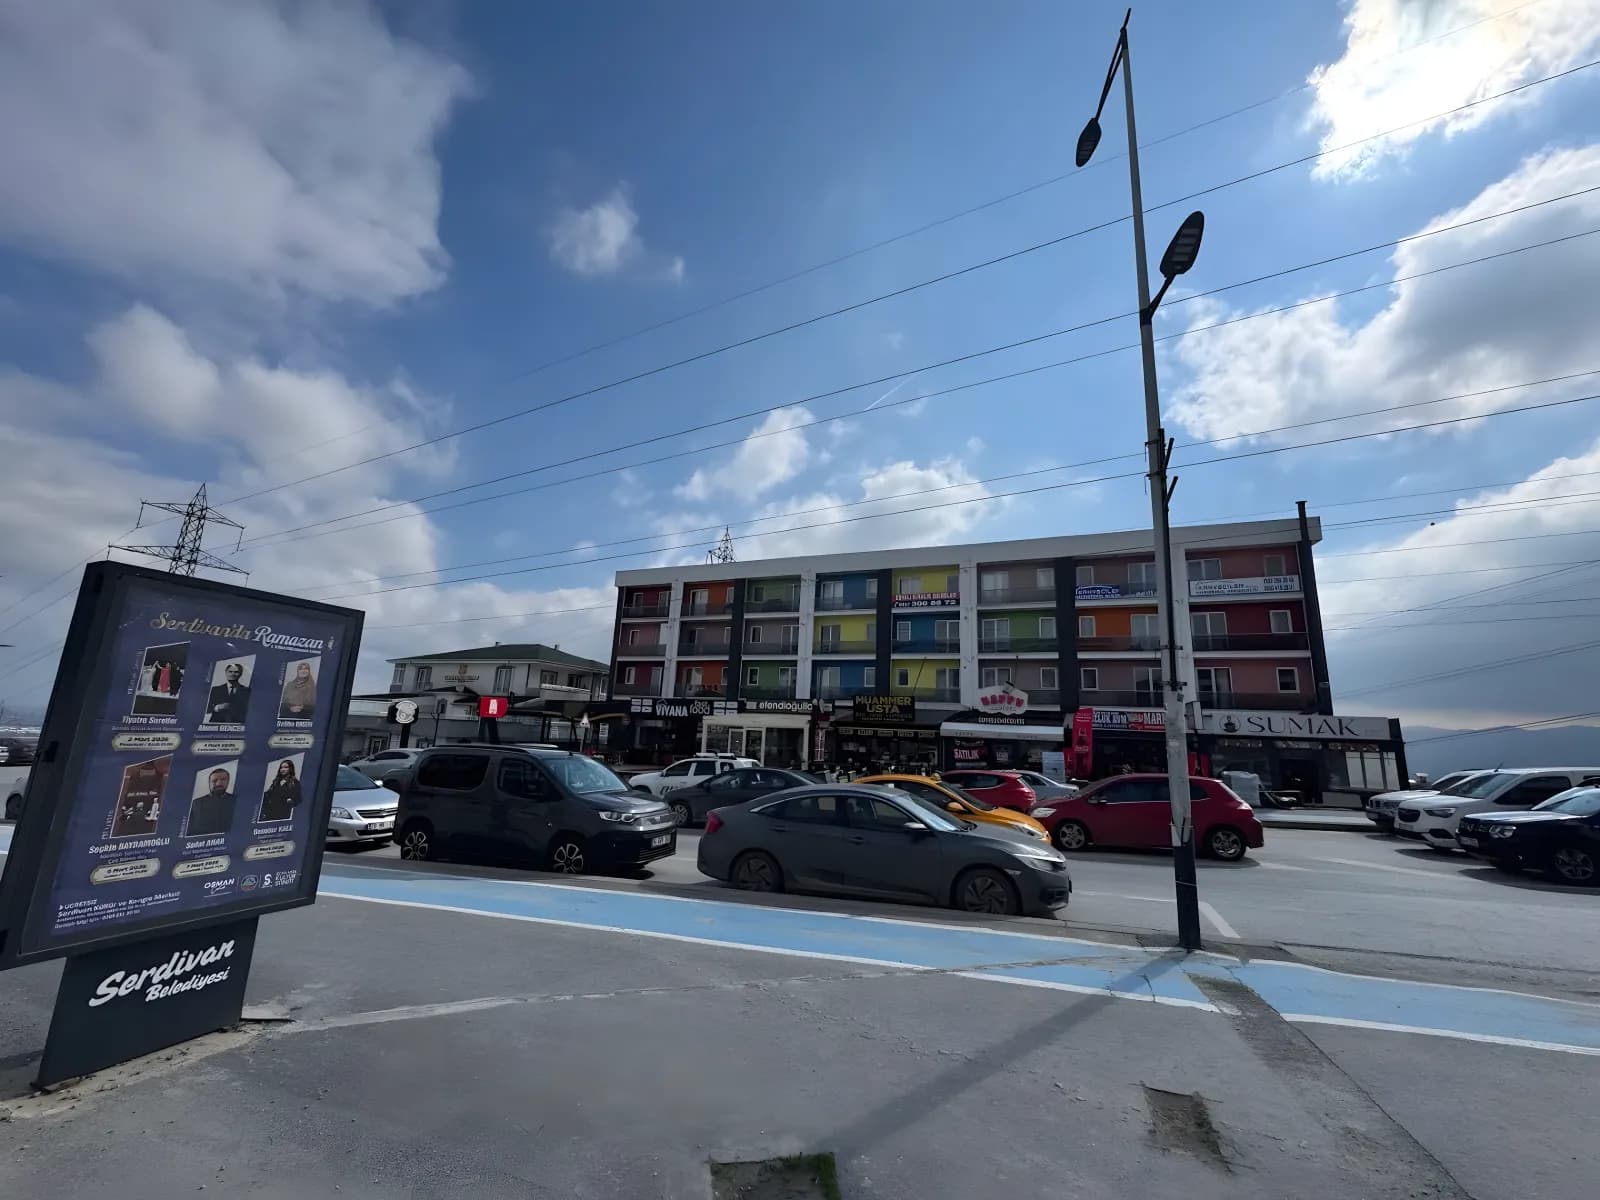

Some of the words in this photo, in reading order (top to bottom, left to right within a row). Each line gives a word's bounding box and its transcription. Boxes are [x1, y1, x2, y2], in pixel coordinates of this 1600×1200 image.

[252, 625, 324, 650] Ramazan
[866, 704, 900, 714] USTA
[1247, 716, 1360, 736] SUMAK
[953, 748, 980, 761] SATILIK
[204, 878, 235, 889] OSMAN
[88, 939, 236, 1007] Serdivan
[145, 966, 231, 1002] Belediyesi
